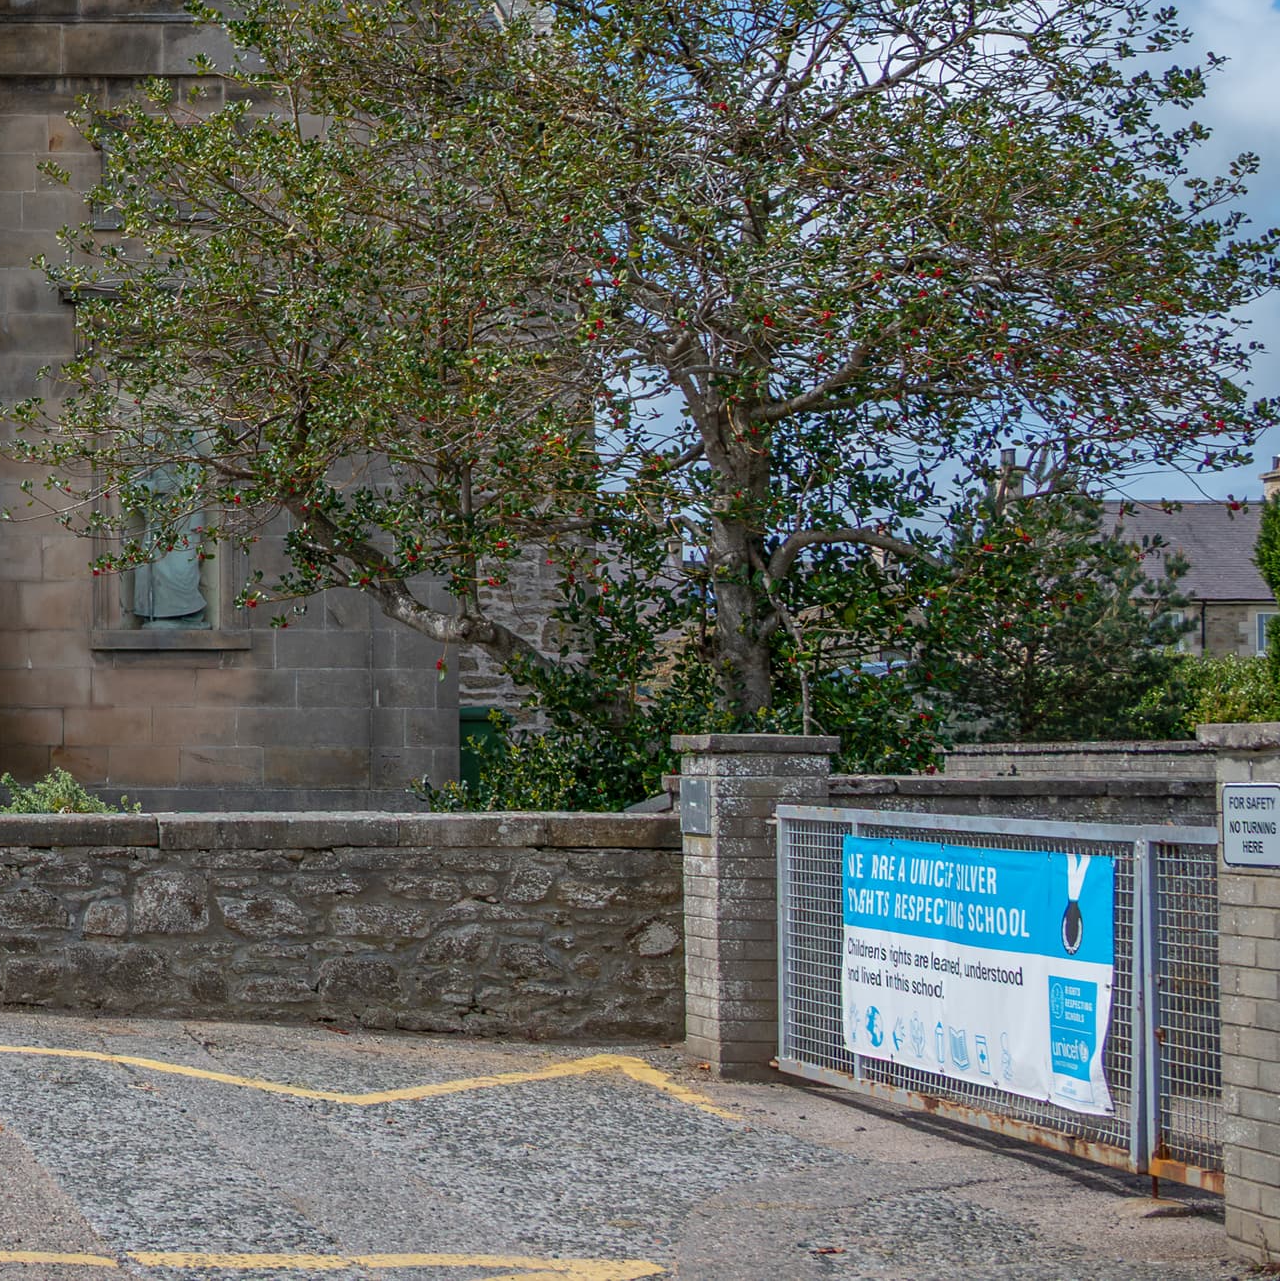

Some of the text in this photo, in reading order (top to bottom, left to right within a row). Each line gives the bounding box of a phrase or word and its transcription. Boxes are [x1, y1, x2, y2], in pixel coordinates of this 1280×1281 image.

[1229, 796, 1276, 810] FOR SAFETY
[1229, 820, 1277, 835] NO TURNING
[1242, 840, 1264, 854] HERE
[871, 854, 896, 881] ARE
[898, 856, 906, 883] A
[956, 864, 997, 895] SILVER
[968, 904, 1030, 938] SCHOOL
[848, 937, 887, 961] Children's
[914, 954, 929, 969] are
[964, 961, 1024, 986] understood
[861, 966, 882, 986] lived
[894, 972, 910, 992] this
[1052, 1038, 1079, 1060] unicef
